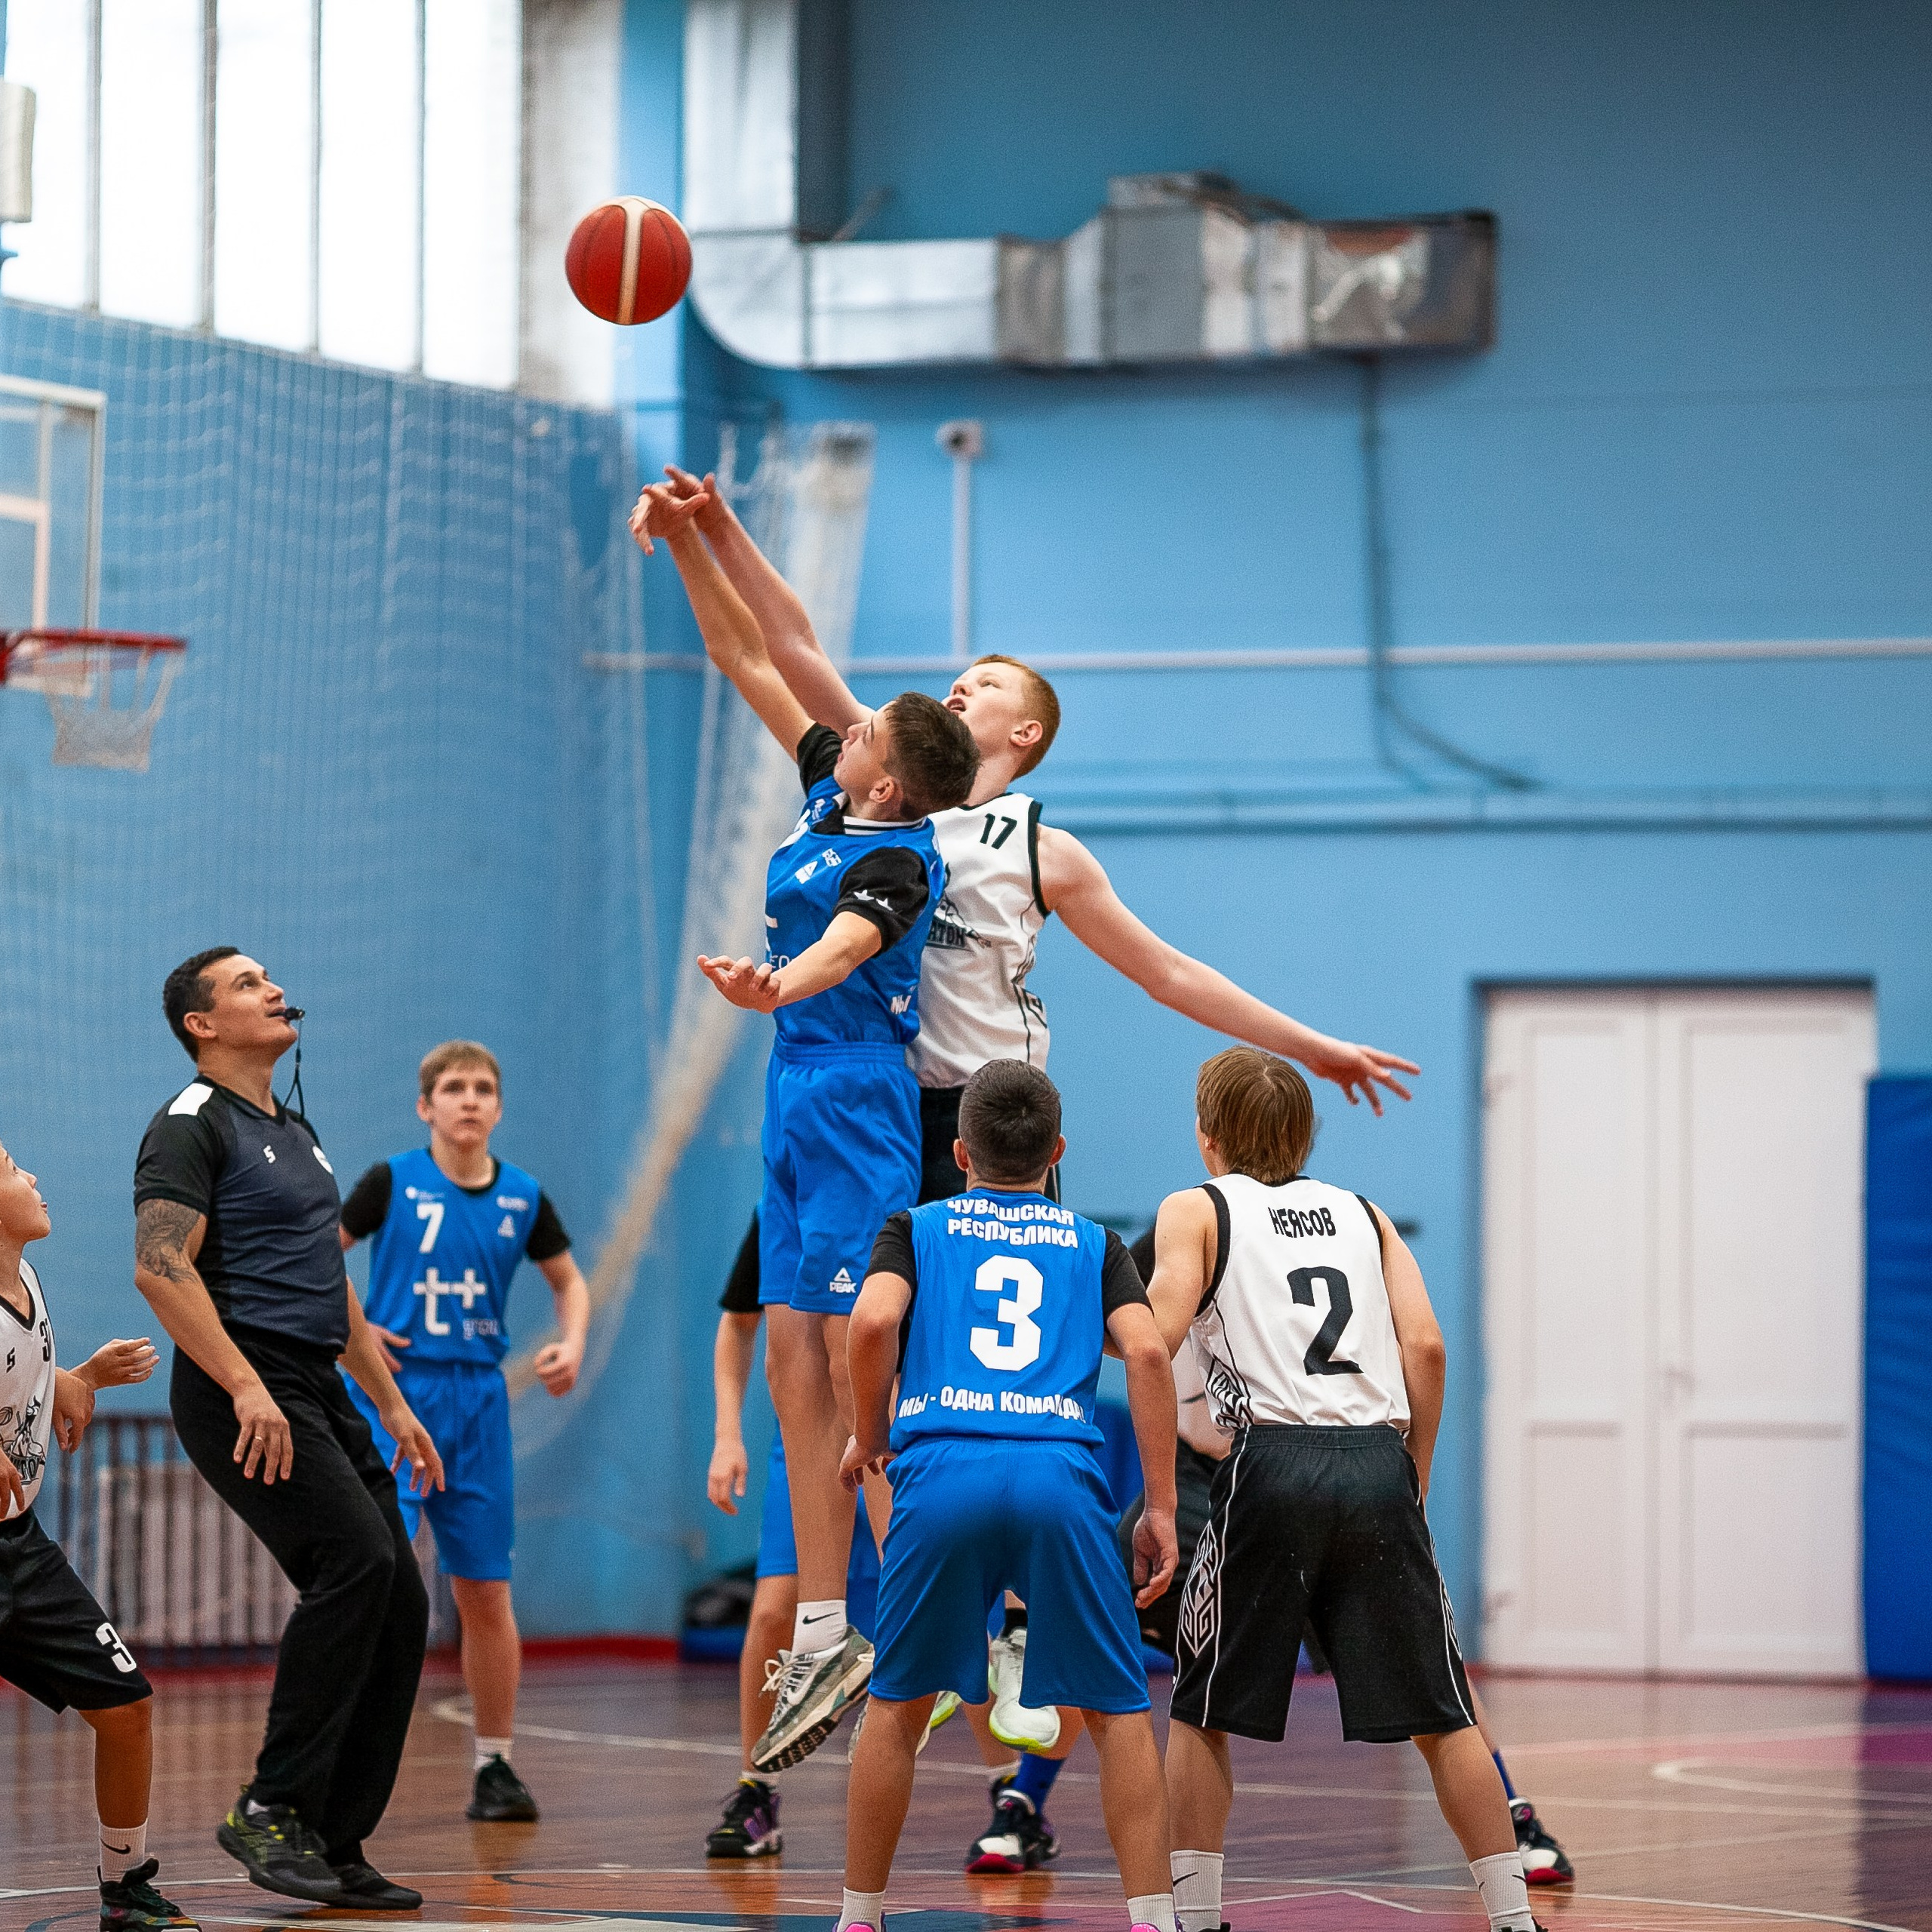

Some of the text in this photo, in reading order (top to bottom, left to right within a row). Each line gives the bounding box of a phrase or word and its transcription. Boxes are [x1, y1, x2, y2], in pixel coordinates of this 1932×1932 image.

[980, 813, 1017, 850] 17
[417, 1202, 445, 1254] 7
[946, 1198, 1075, 1226] ЧУВАШСКАЯ
[1268, 1207, 1336, 1238] НЕЯСОВ
[948, 1217, 1078, 1249] РЕСПУБЛИКА
[829, 1281, 857, 1294] PEAK
[970, 1255, 1044, 1371] 3
[1286, 1266, 1364, 1376] 2
[898, 1392, 929, 1418] МЫ
[940, 1386, 994, 1411] ОДНА
[95, 1622, 137, 1673] 3
